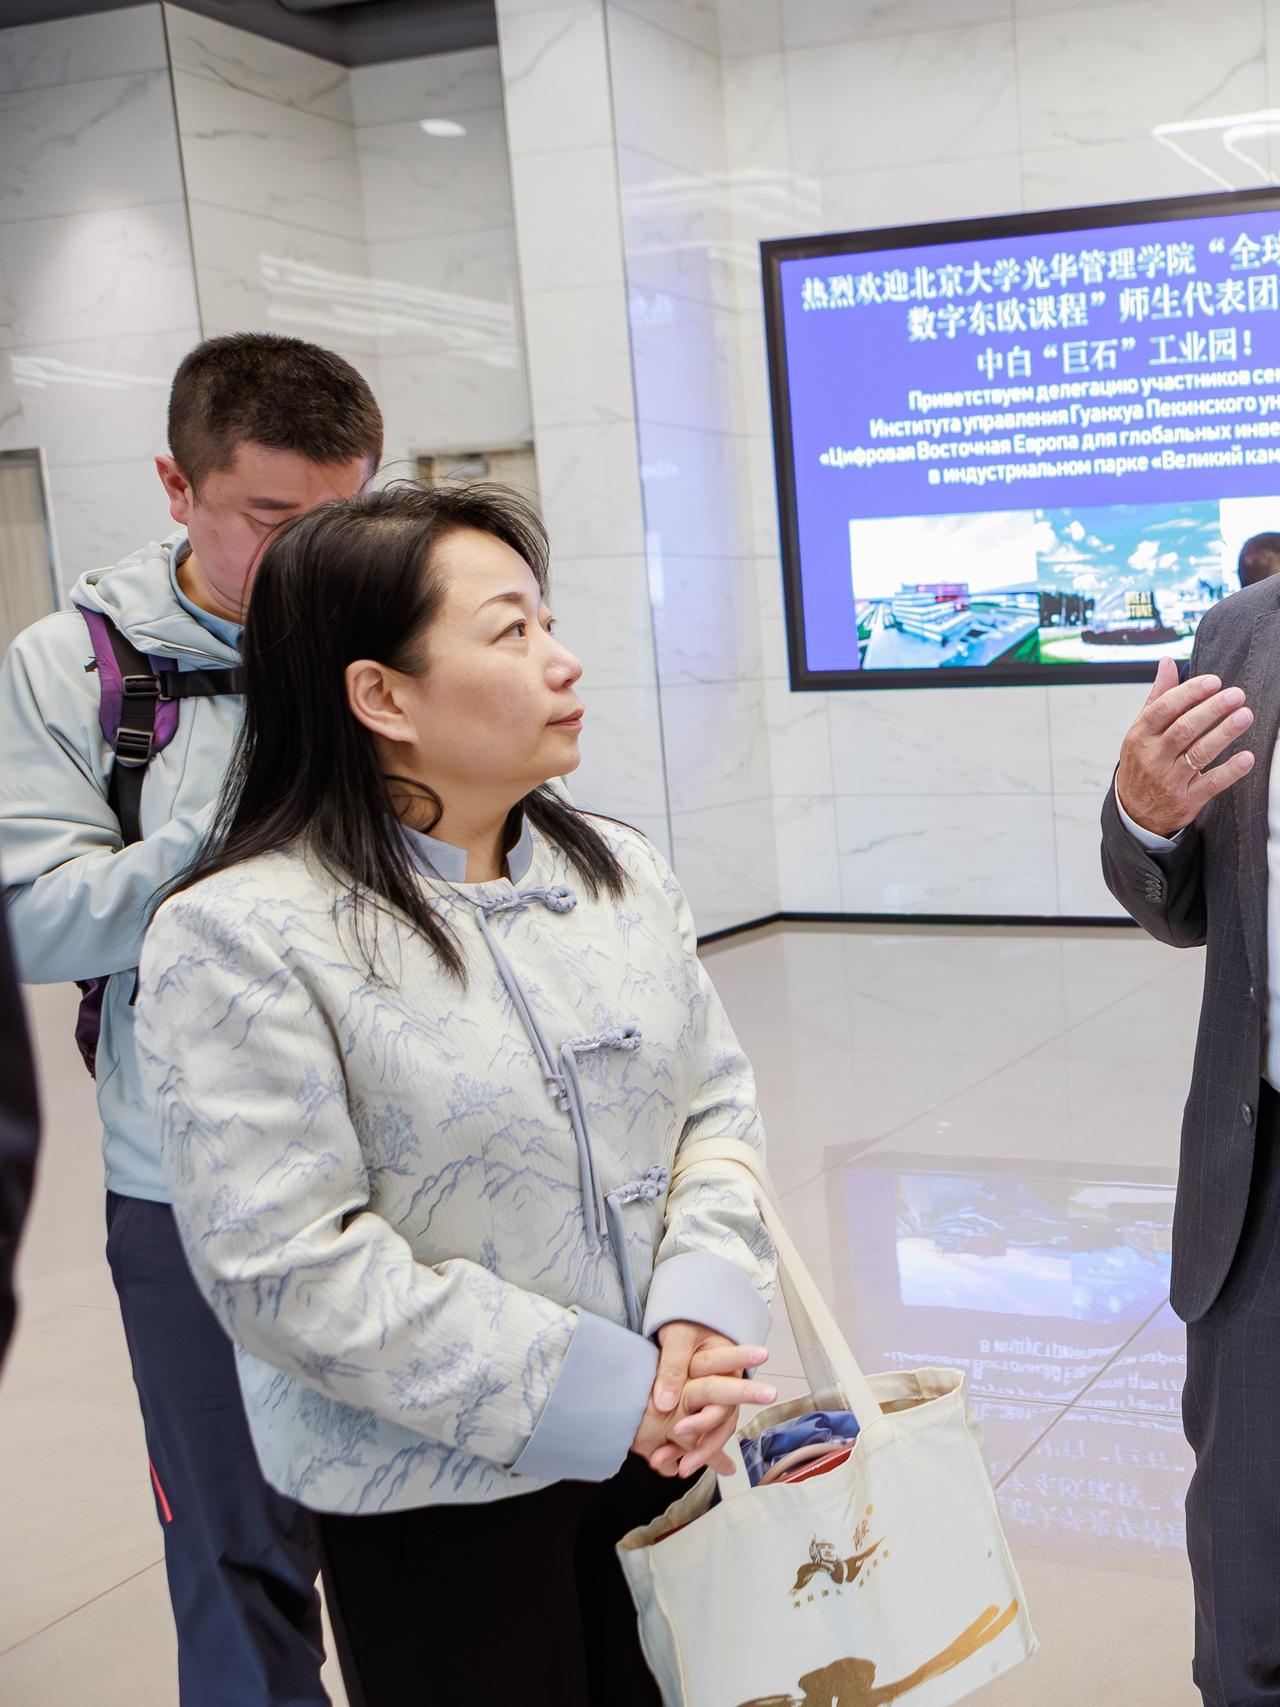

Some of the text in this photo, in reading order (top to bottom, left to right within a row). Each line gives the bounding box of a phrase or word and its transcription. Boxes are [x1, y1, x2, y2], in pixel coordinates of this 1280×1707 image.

[908, 385, 1034, 414] Приветствуем
[1036, 375, 1139, 404] делегацию
[1141, 369, 1251, 397] участников
[869, 416, 962, 439] Института
[962, 408, 1069, 436] управления
[1070, 403, 1144, 428] Гуанхуа
[1145, 395, 1257, 420] Пекинского
[819, 445, 916, 470] «Цифровая
[916, 438, 1012, 461] Восточная
[1013, 432, 1079, 457] Европа
[1081, 431, 1115, 452] для
[1118, 422, 1233, 447] глобальных
[928, 467, 940, 486] в
[943, 457, 1092, 488] индустриальном
[1093, 455, 1149, 478] парке
[1150, 444, 1245, 471] «Великий
